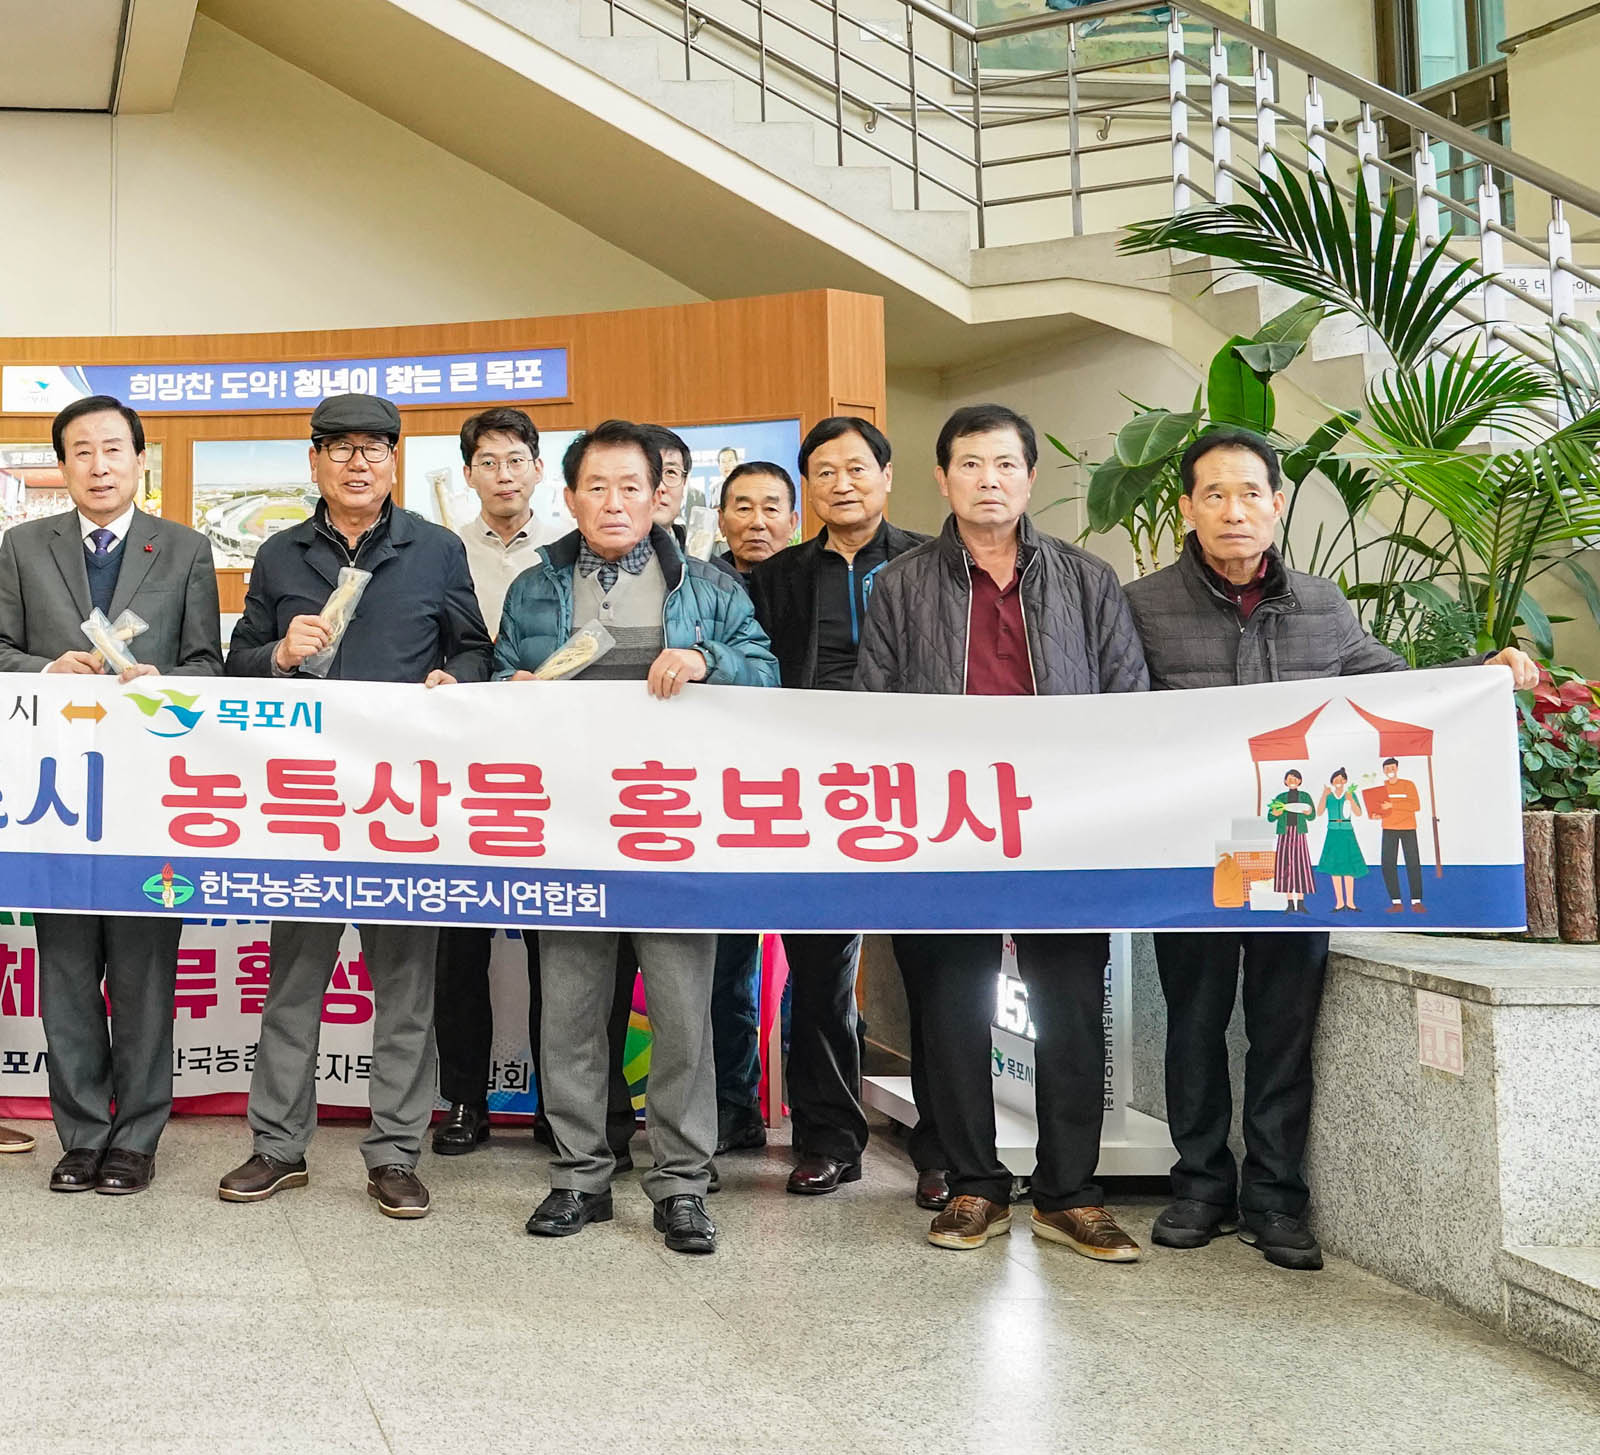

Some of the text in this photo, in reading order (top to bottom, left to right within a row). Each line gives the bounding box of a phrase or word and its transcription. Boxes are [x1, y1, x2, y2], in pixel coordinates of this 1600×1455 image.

[129, 359, 543, 401] 희망찬 도약! 청년이 찾는 큰 목포
[216, 700, 322, 734] 목포시
[161, 755, 551, 858] 농특산물
[609, 760, 1033, 862] 홍보행사
[199, 870, 607, 918] 한국농촌지도자영주시연합회
[1007, 1057, 1034, 1087] 목포시
